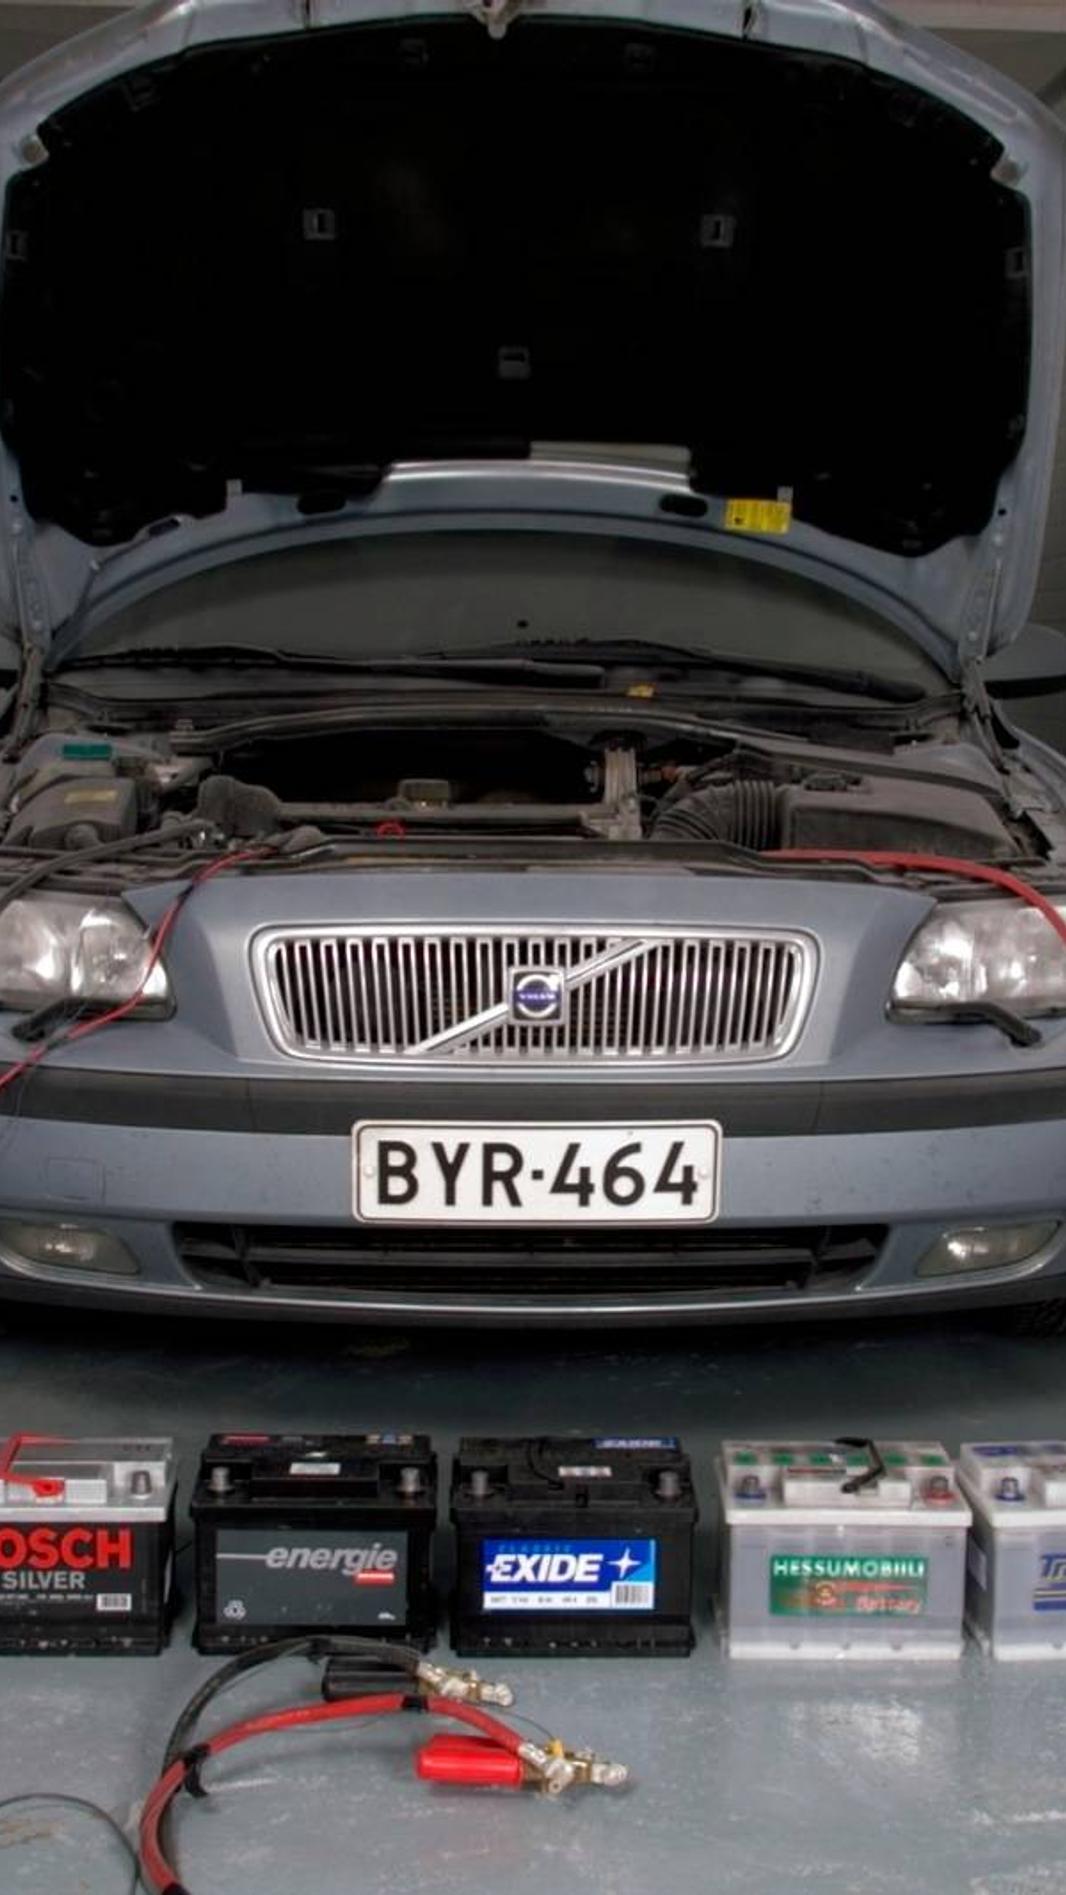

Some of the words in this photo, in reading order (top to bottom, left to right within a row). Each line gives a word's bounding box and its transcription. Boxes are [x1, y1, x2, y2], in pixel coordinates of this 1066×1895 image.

[265, 1542, 397, 1576] energie
[486, 1553, 604, 1583] EXIDE
[773, 1559, 925, 1577] HESSUMOBIILI
[2, 1571, 86, 1590] SILVER
